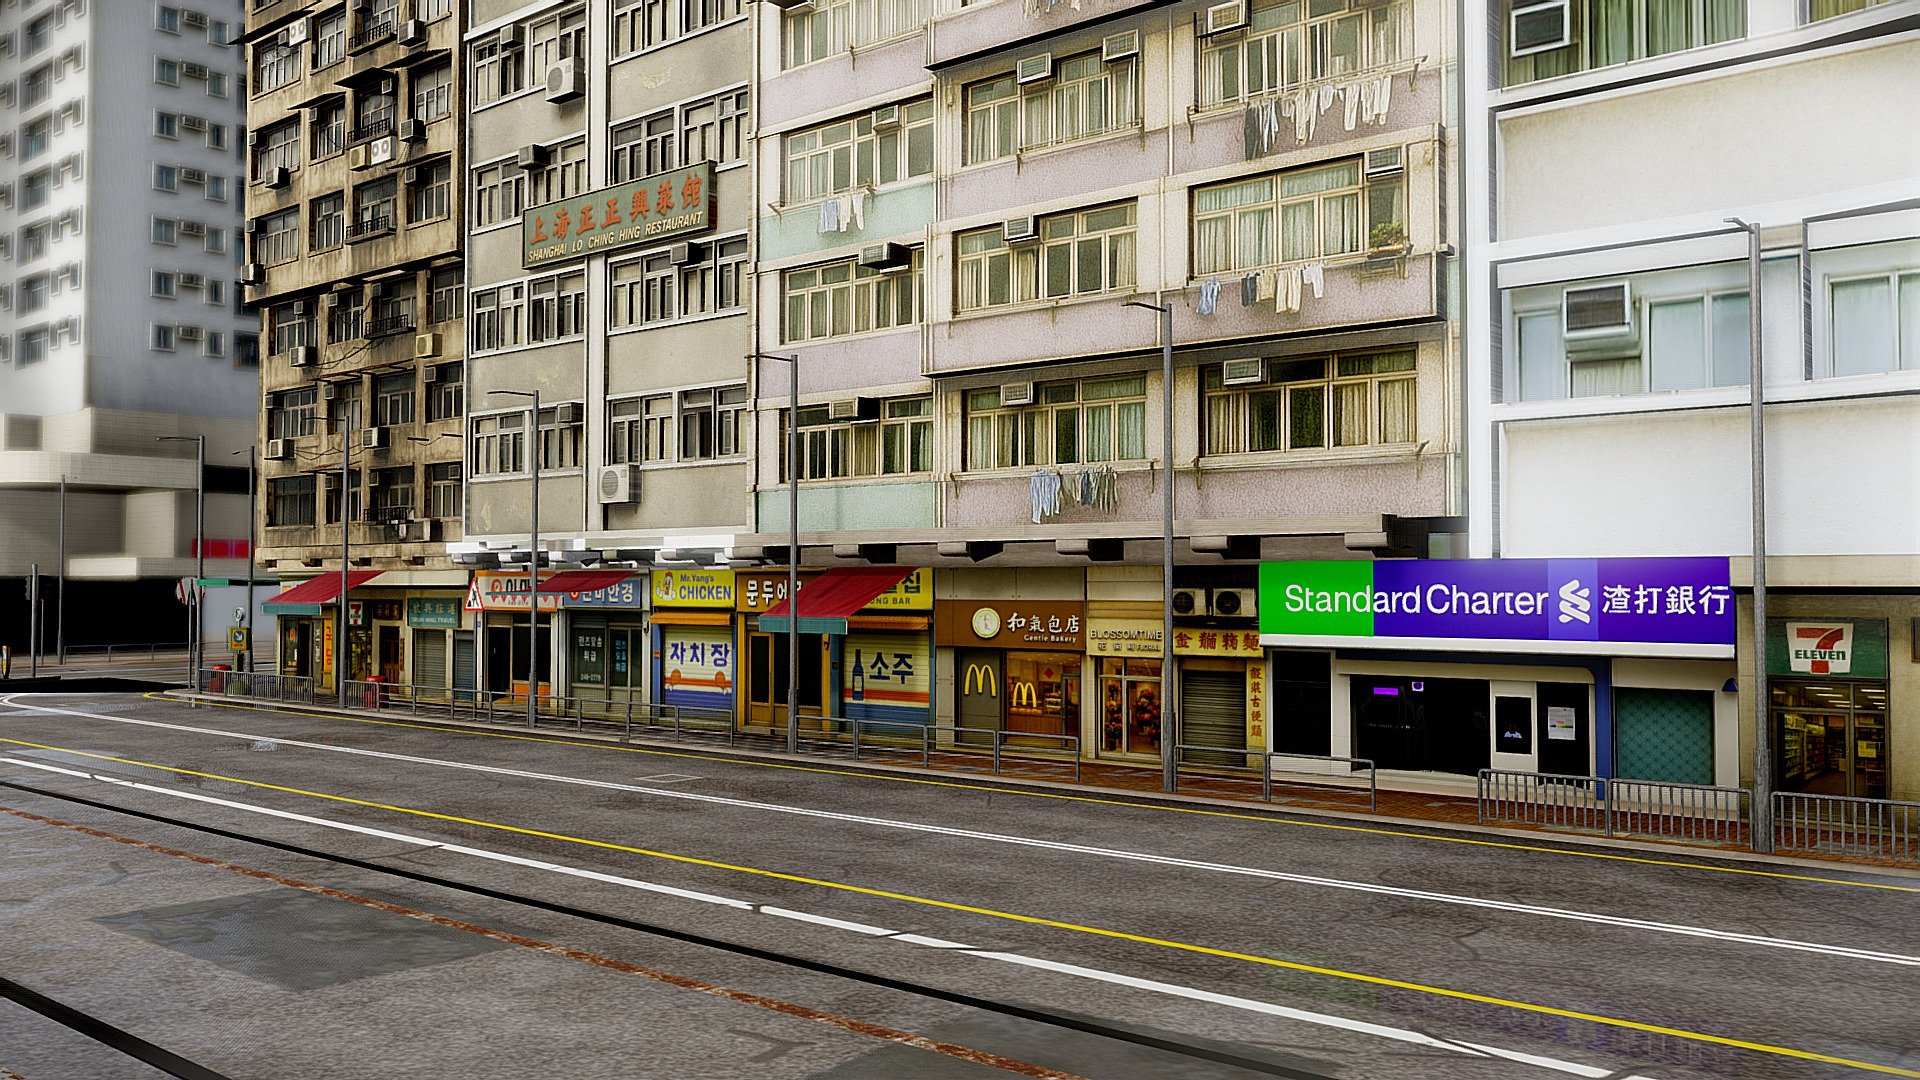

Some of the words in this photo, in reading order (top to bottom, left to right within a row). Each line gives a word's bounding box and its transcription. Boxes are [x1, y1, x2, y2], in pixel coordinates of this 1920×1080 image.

[528, 245, 567, 262] SHANGHAI
[572, 239, 583, 252] LO
[588, 232, 614, 248] CHING
[619, 226, 640, 242] HING
[645, 211, 703, 236] RESTAURANT
[680, 585, 732, 600] CHICKEN
[745, 579, 803, 607] 문두어
[884, 571, 921, 594] 집
[892, 597, 911, 605] BAR
[1285, 584, 1421, 614] Standard
[1426, 584, 1549, 615] Charter
[1602, 584, 1730, 615] 渣打銀行
[1007, 612, 1080, 633] 和氣包店
[1024, 634, 1049, 642] Gentle
[1050, 634, 1077, 643] Bakery
[1090, 629, 1162, 641] BLOSSOMTIME
[670, 641, 729, 667] 자치장
[869, 651, 914, 684] 소주
